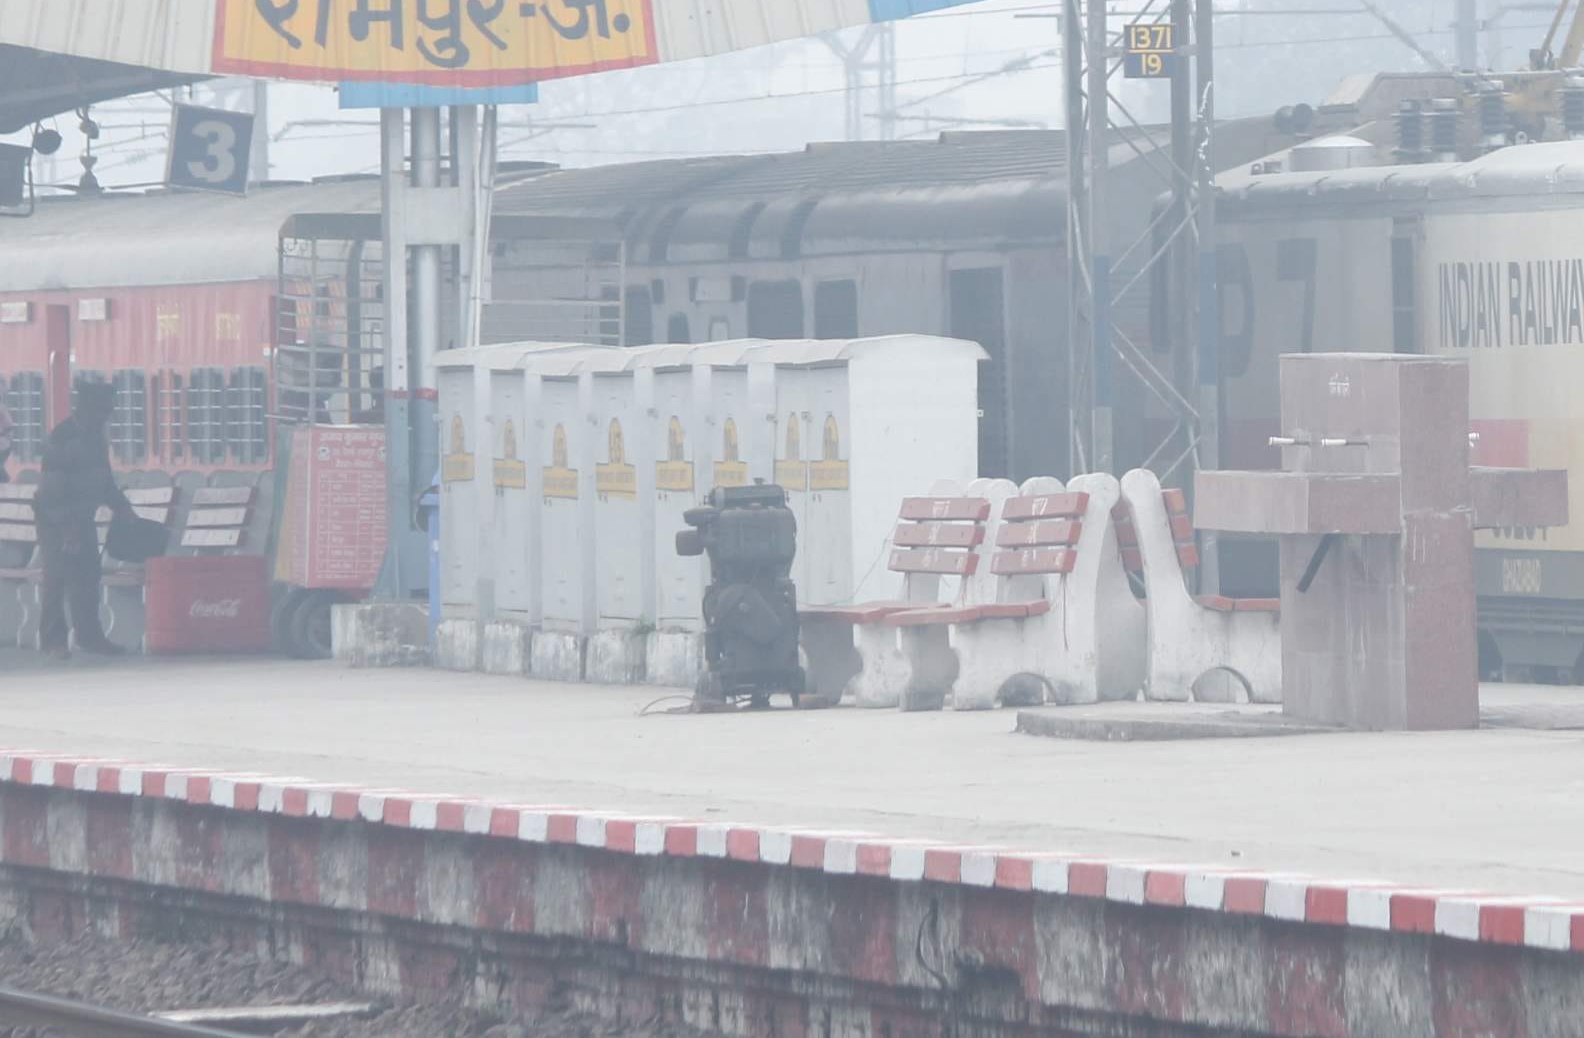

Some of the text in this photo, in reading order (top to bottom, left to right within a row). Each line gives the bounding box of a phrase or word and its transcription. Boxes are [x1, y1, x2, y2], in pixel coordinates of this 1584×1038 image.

[1130, 26, 1171, 49] 1371
[1141, 53, 1162, 75] 19
[186, 120, 237, 184] 3
[1438, 262, 1501, 349] INDIAN
